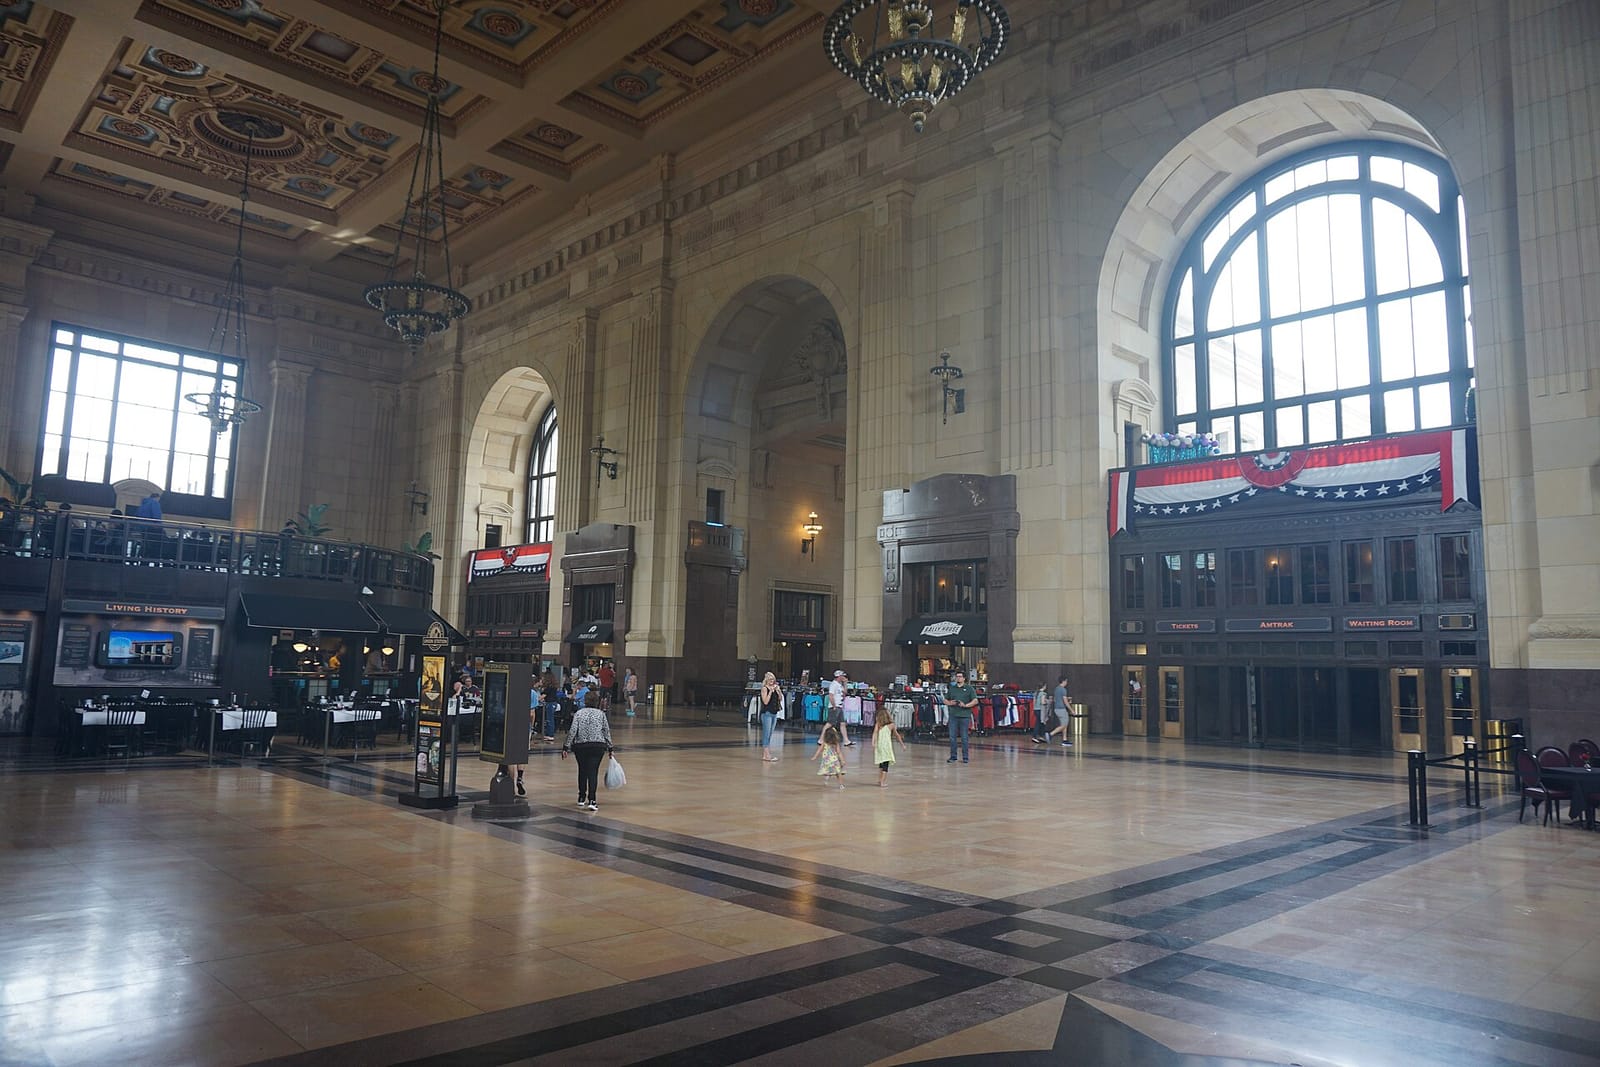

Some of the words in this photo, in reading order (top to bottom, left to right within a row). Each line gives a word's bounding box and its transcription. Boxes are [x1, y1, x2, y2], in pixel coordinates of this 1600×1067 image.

[105, 603, 141, 612] LIVING
[144, 605, 188, 615] HISTORY
[1260, 621, 1294, 629] AMTRAK
[1348, 620, 1385, 628] WAITING
[1387, 619, 1414, 627] ROOM
